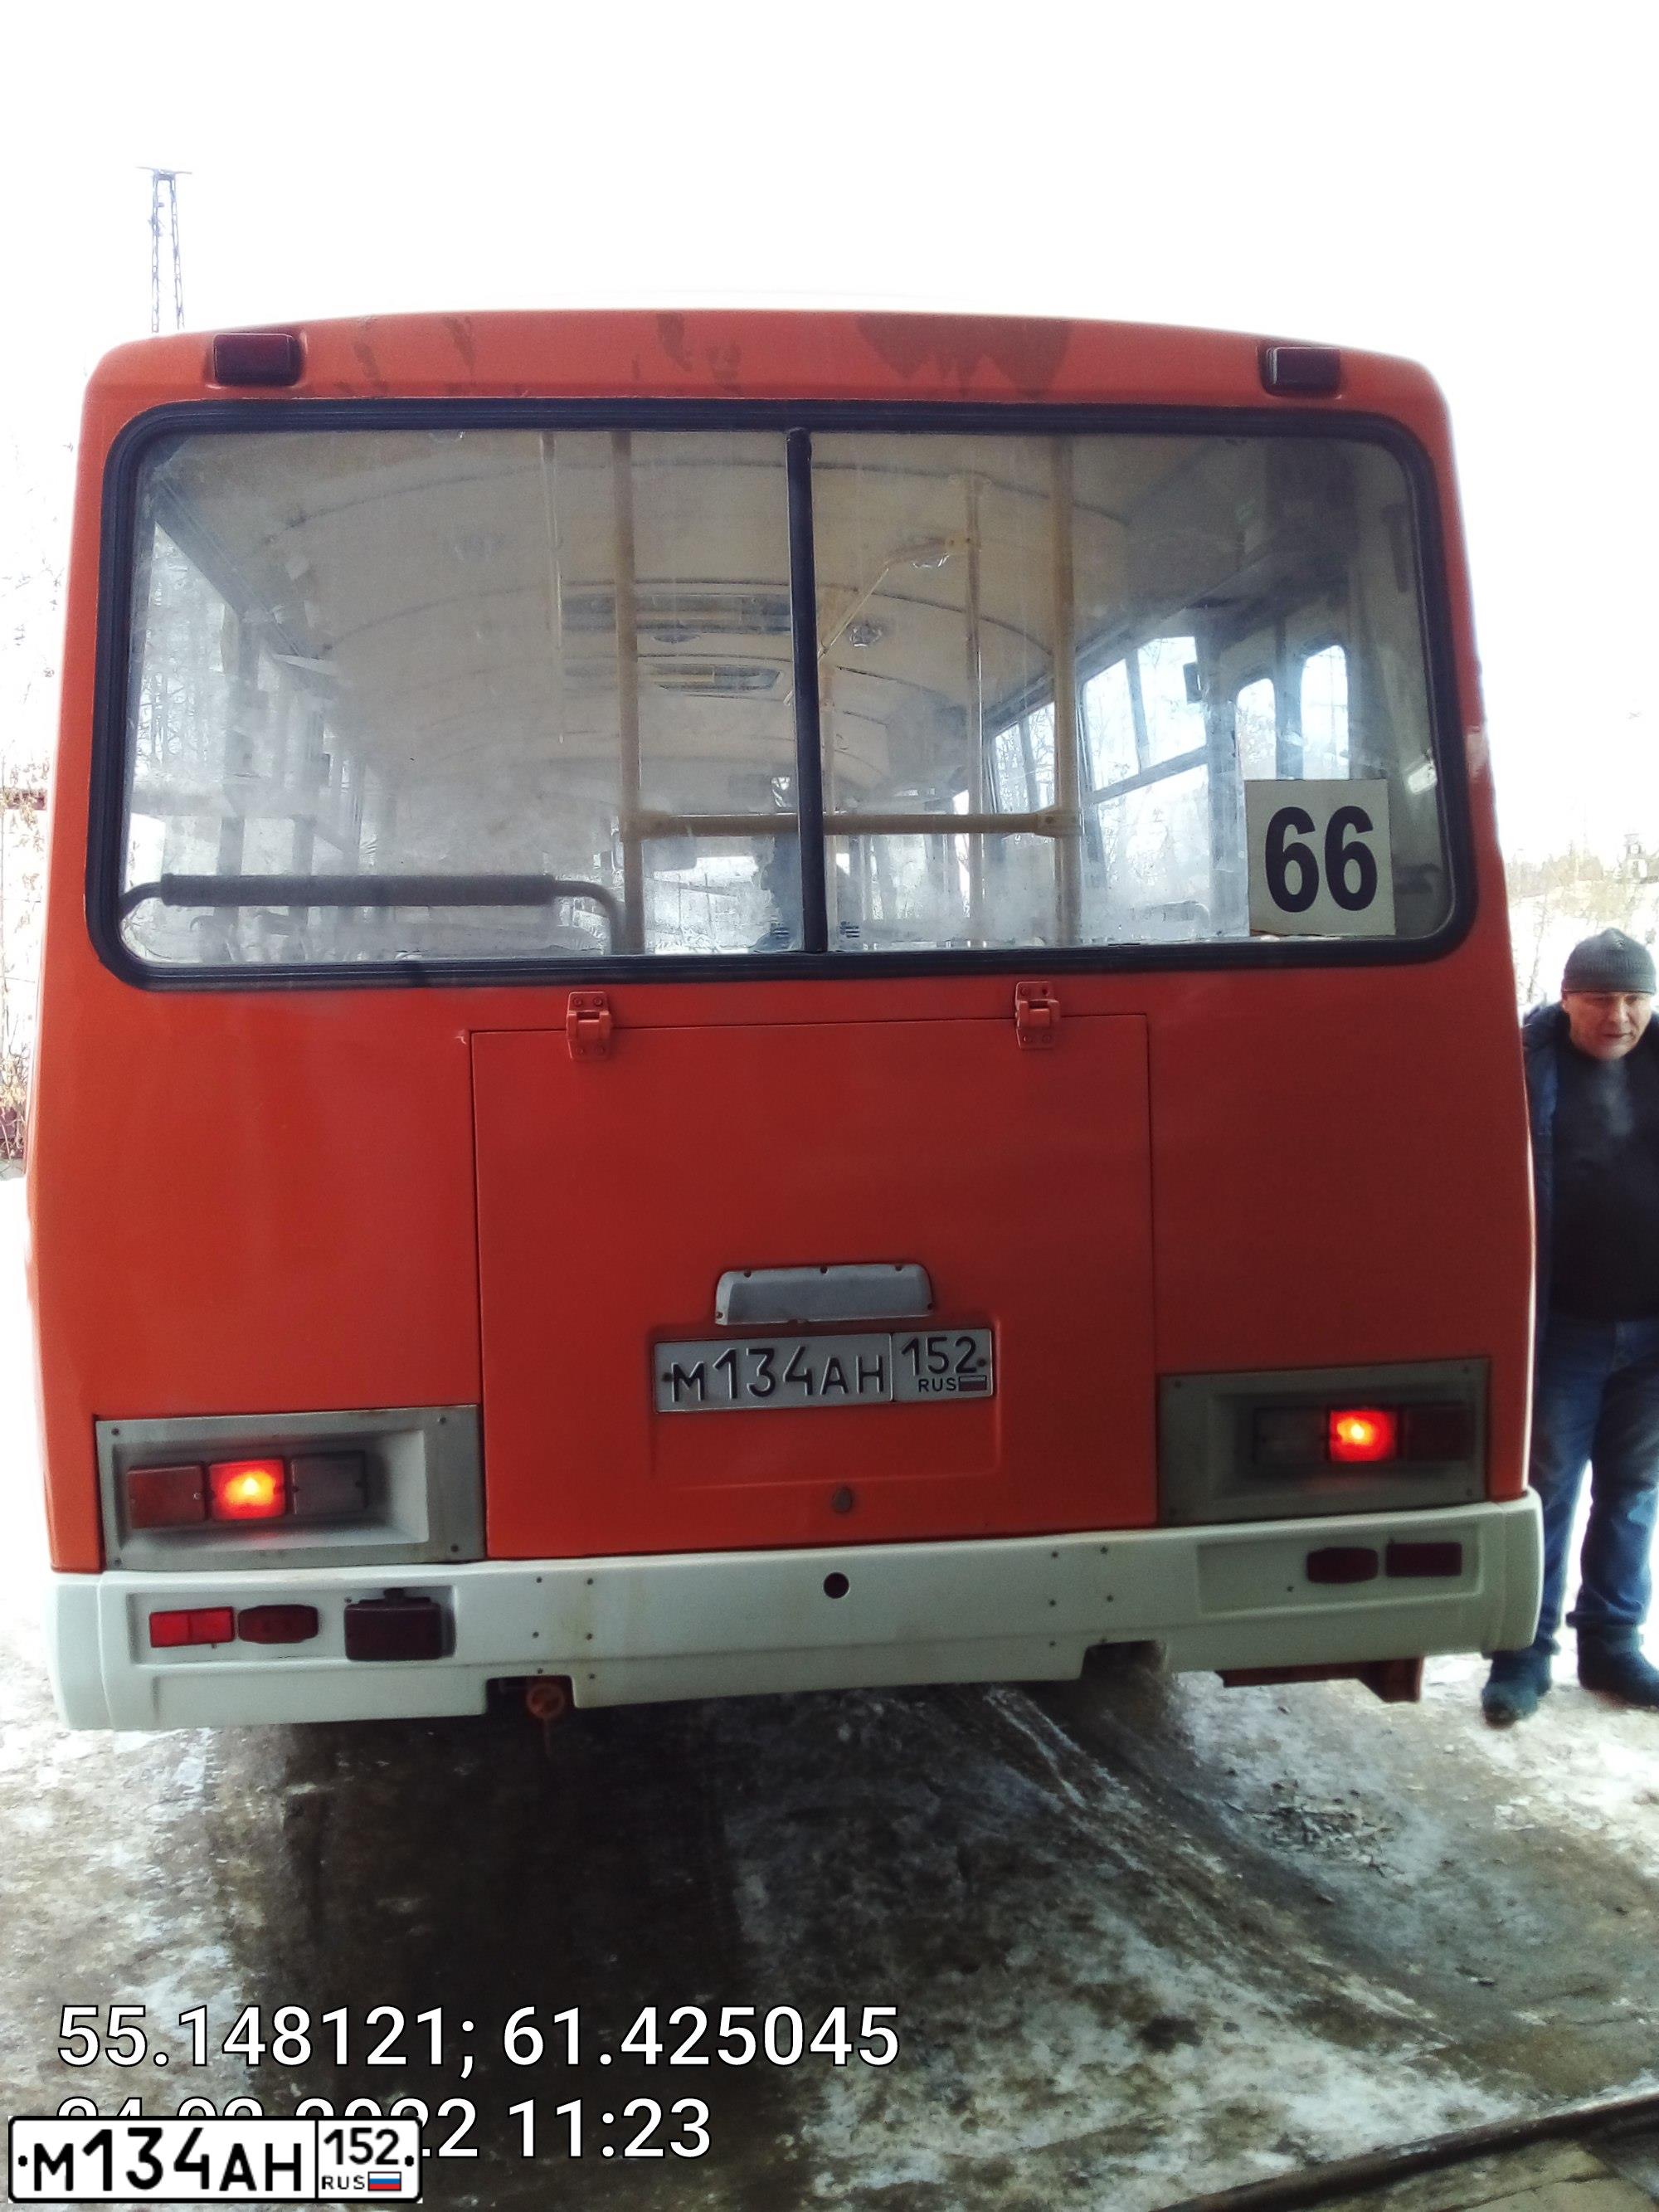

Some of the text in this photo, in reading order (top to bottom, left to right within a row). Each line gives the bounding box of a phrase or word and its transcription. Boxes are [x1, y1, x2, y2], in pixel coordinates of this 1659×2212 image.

[1265, 806, 1378, 913] 66
[901, 1336, 977, 1376] 152
[918, 1378, 956, 1393] RUS
